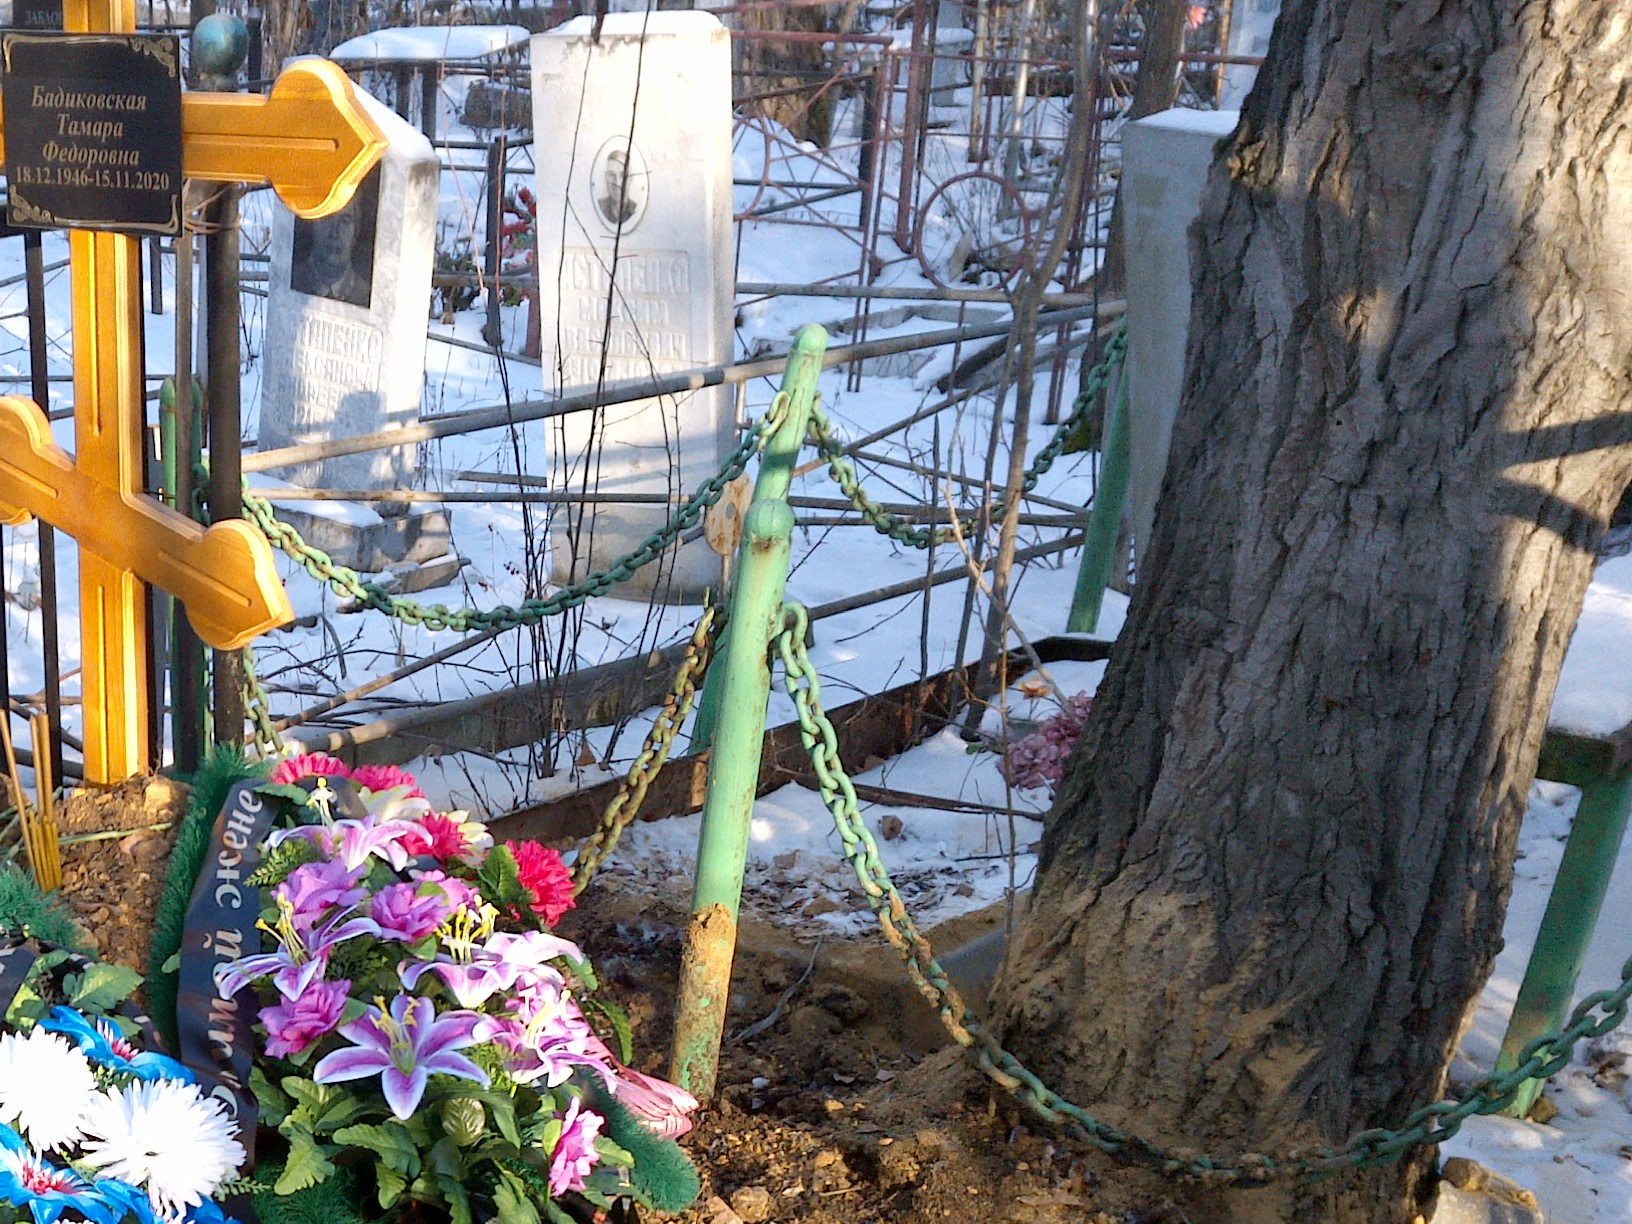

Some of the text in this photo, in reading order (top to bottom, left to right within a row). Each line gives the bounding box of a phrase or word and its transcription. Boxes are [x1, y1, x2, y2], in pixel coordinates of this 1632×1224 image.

[24, 10, 62, 26] ЗАБЛО
[31, 85, 147, 111] Бадиковская
[56, 113, 124, 142] Тамара
[42, 140, 140, 169] Федоровна
[15, 166, 170, 191] 18.12.1946-15.11.2020
[215, 788, 263, 909] жене
